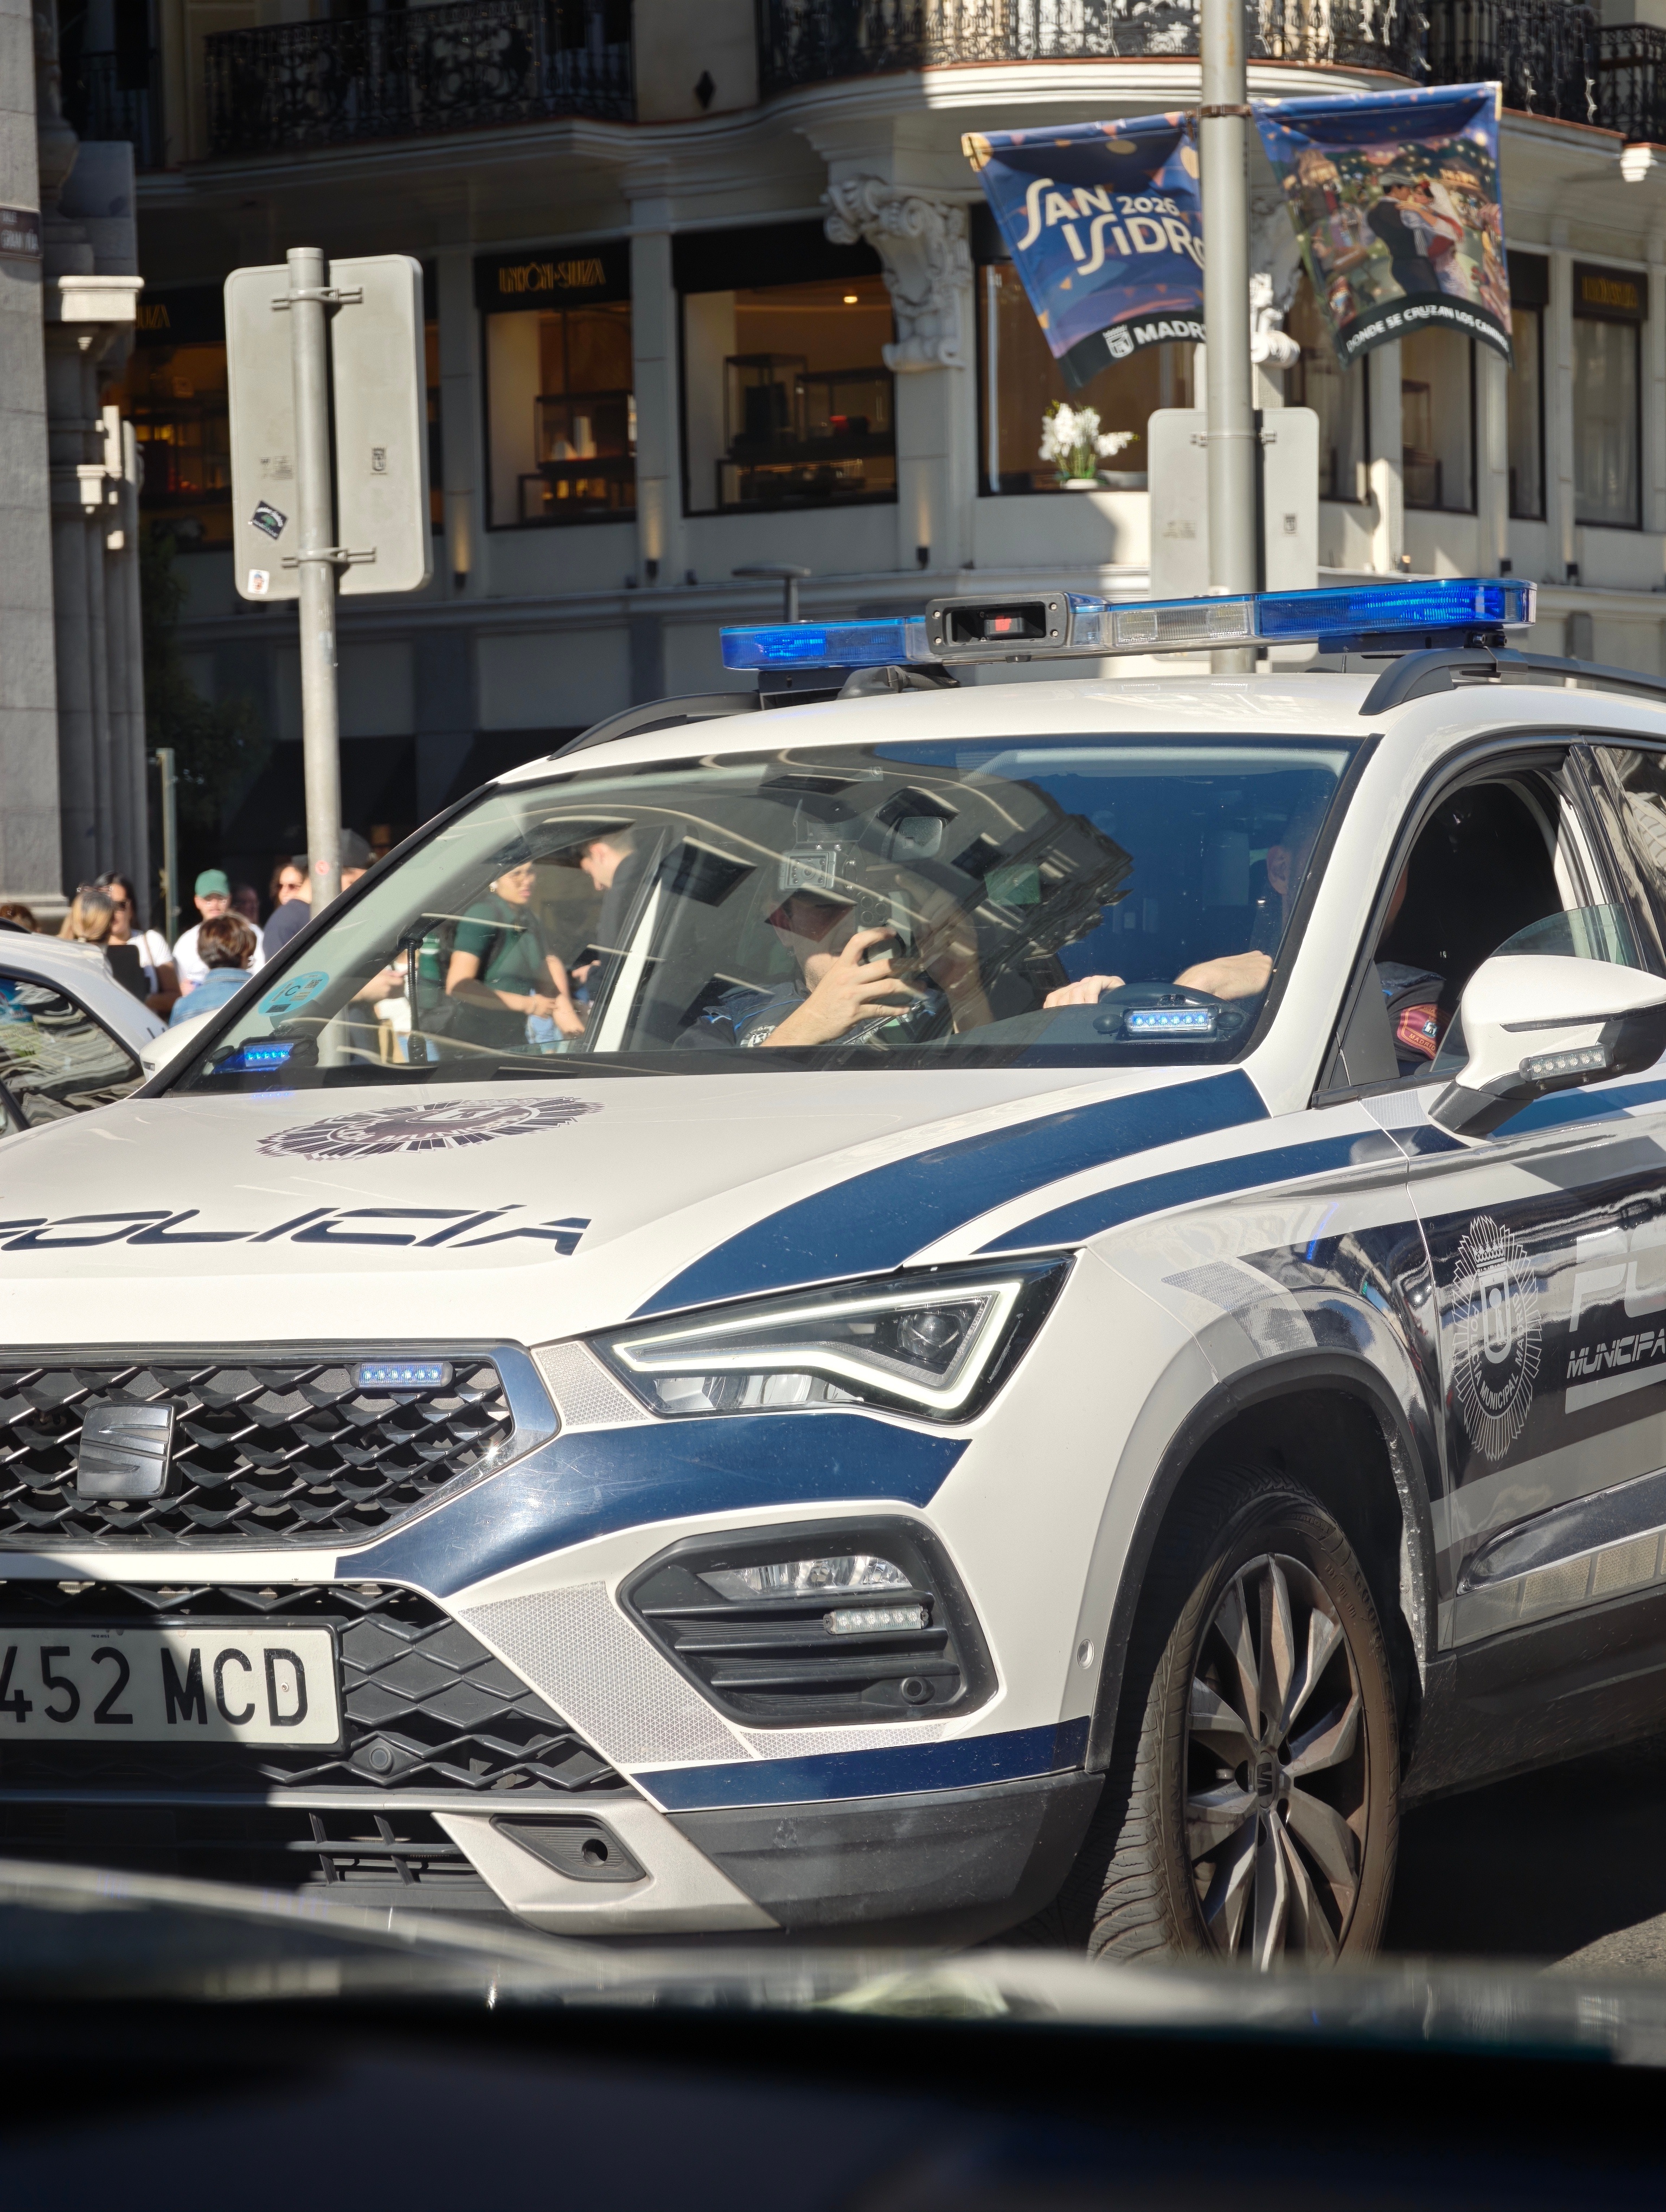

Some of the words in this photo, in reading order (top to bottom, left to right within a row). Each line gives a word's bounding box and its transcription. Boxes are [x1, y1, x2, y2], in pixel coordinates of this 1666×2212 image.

[1017, 178, 1113, 251] SAN
[1116, 196, 1181, 216] 2026
[1133, 320, 1206, 345] MADR
[1345, 320, 1386, 353] DONDE
[1386, 313, 1403, 329] SE
[1404, 305, 1455, 321] CRUZAN
[1455, 309, 1476, 327] LOS
[1408, 1033, 1436, 1051] MADRID
[1479, 1373, 1519, 1411] MUNICIPAL
[1515, 1292, 1526, 1367] MADRID
[0, 1645, 133, 1724] 452
[160, 1648, 309, 1727] MCD
